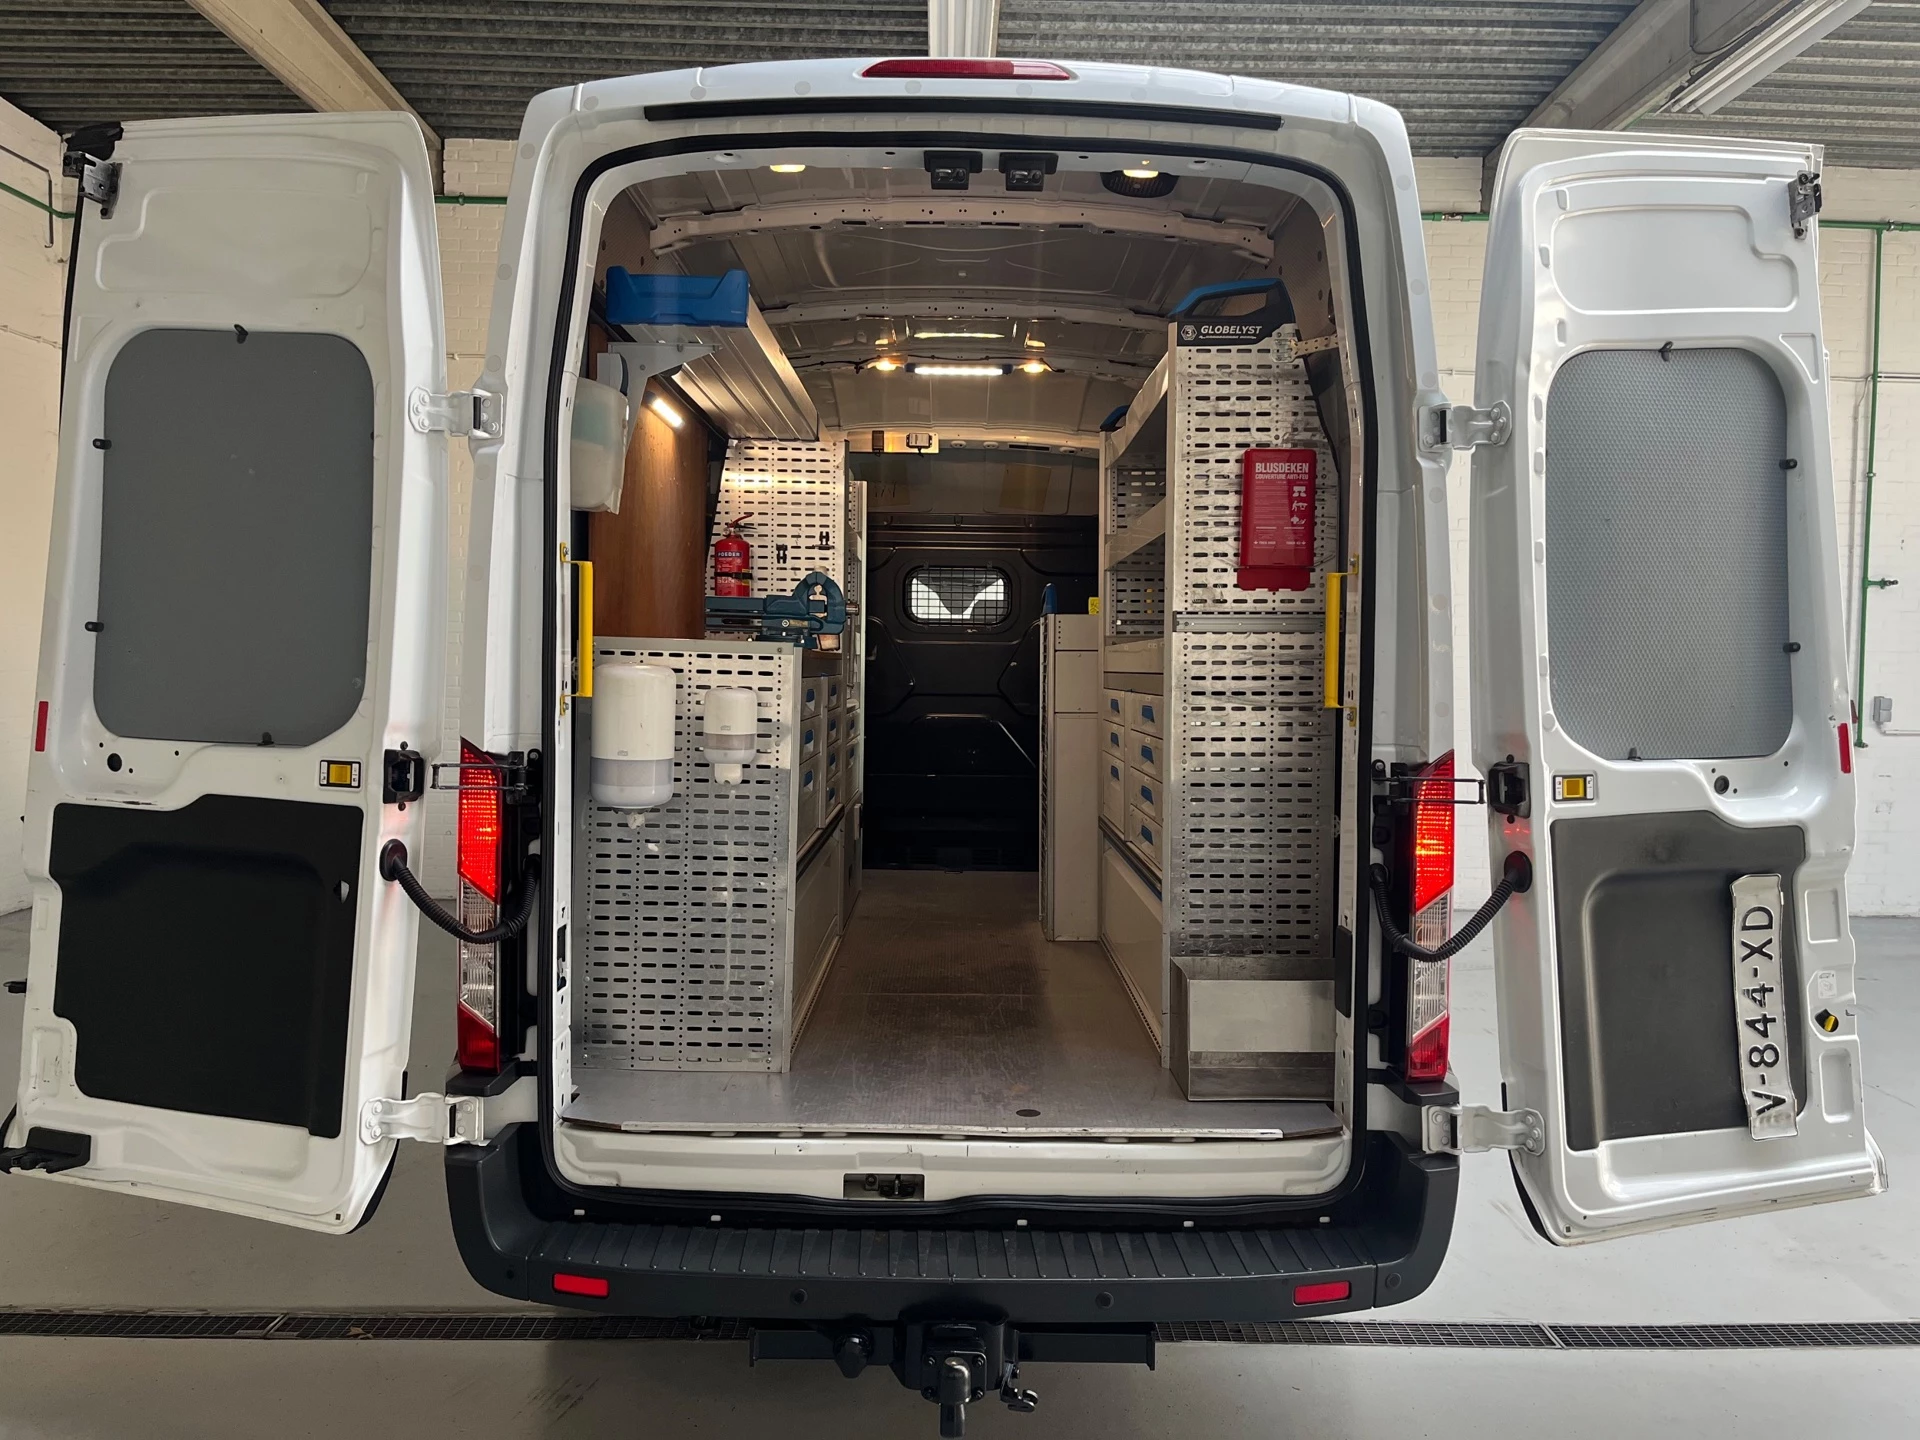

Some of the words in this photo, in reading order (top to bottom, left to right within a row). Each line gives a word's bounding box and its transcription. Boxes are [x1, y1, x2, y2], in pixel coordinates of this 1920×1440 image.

[1200, 325, 1262, 334] GLOBELYST
[1255, 462, 1309, 473] BLUSDEKEN
[1741, 906, 1787, 1117] V-844-XD
